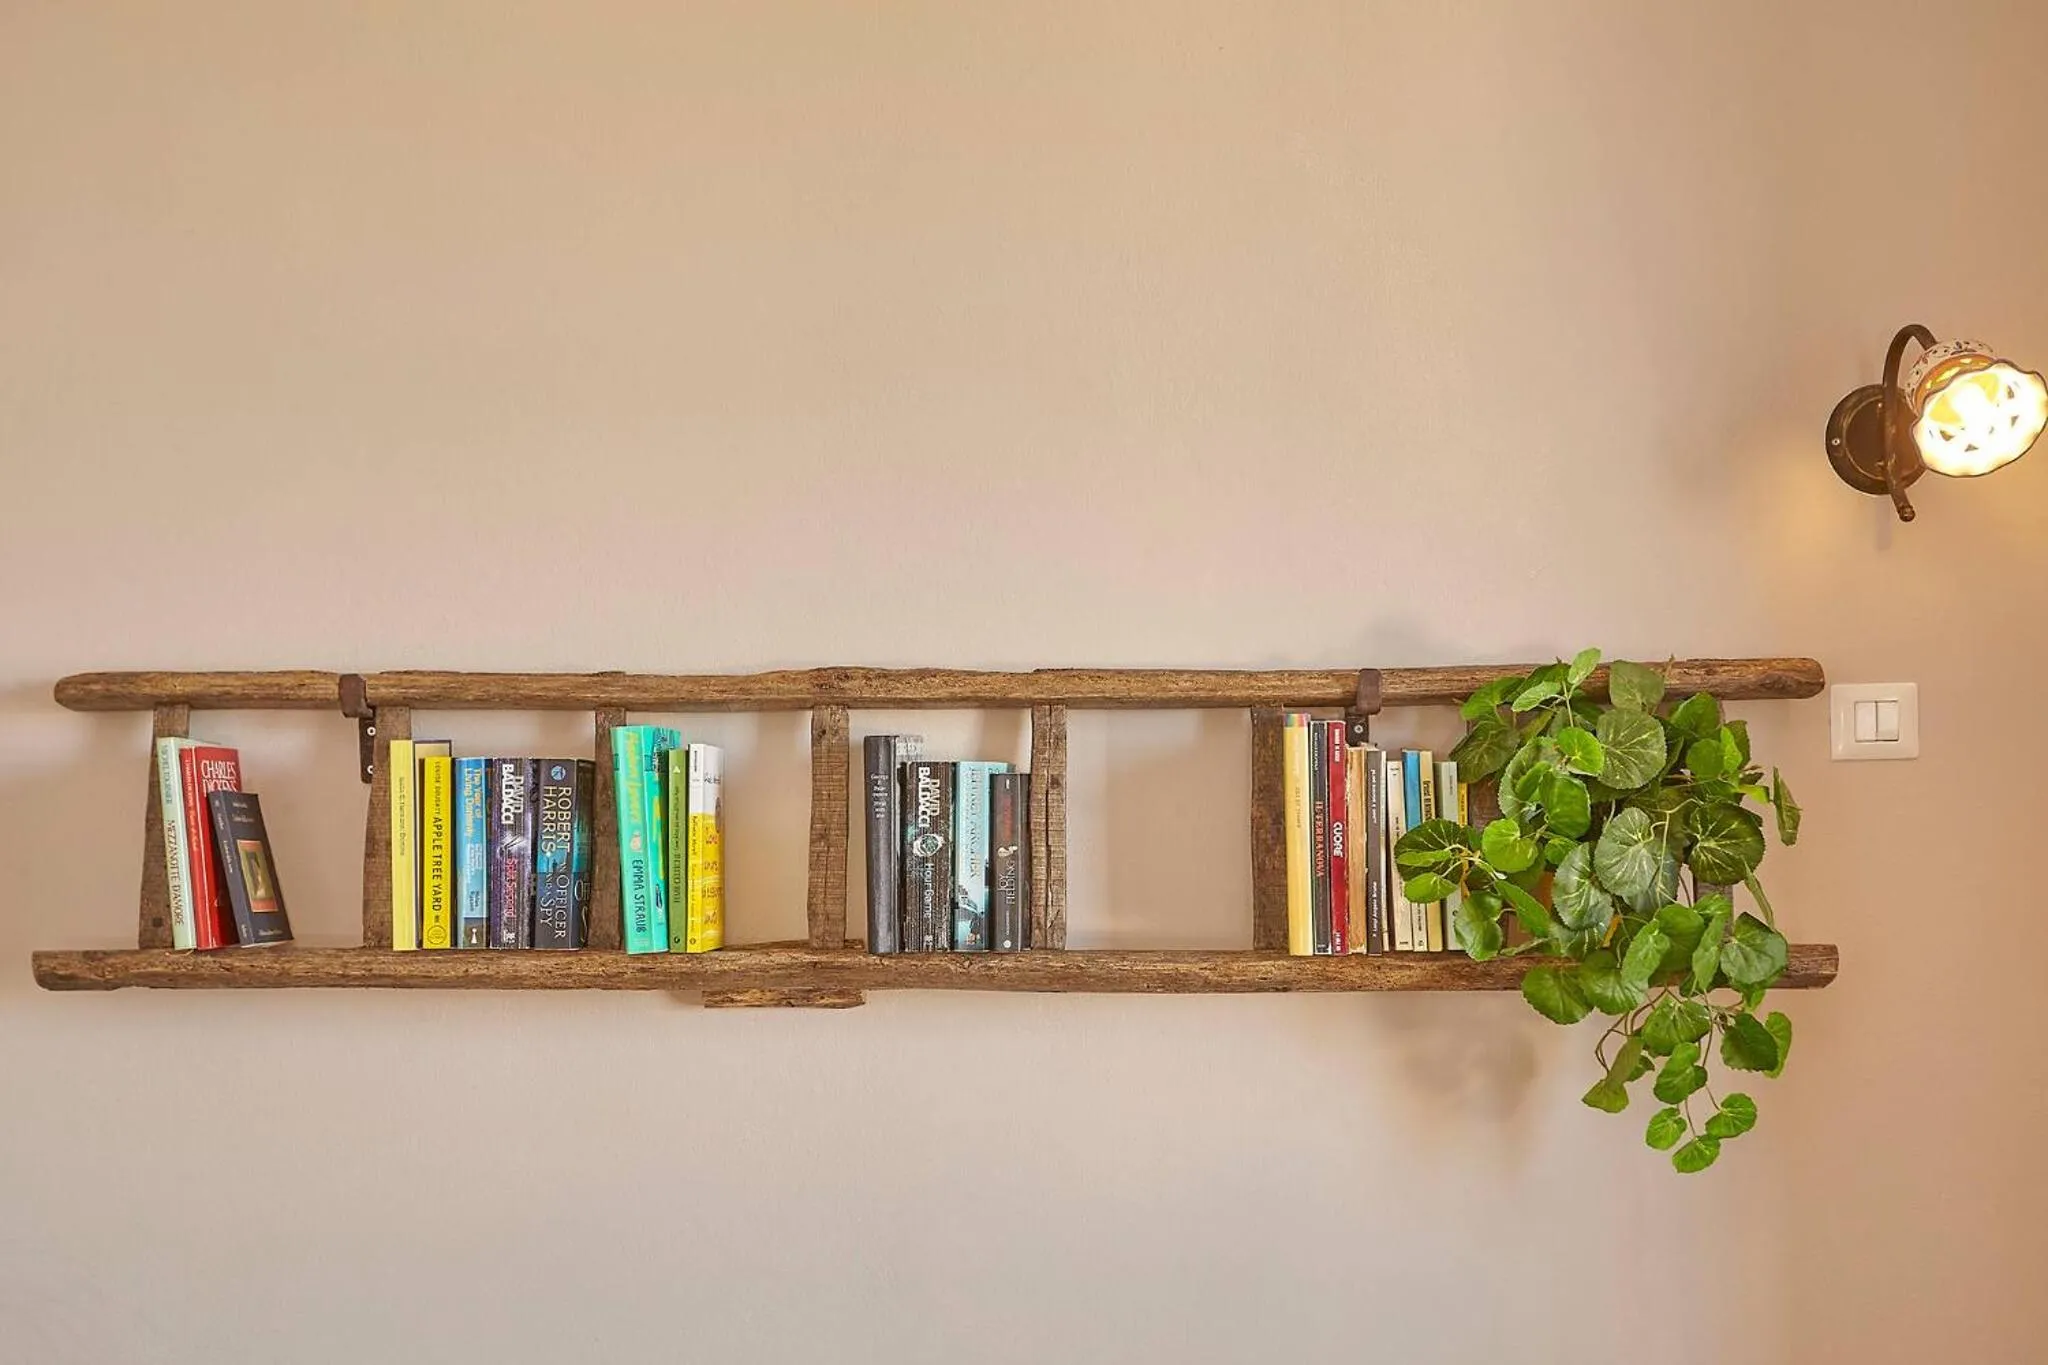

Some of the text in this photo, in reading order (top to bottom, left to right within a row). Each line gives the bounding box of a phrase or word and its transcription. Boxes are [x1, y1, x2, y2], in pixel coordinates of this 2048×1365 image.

[202, 760, 237, 779] CHARLES
[502, 763, 514, 825] BALDACCI
[514, 775, 524, 813] DAVID
[918, 766, 931, 828] BALDACCI
[930, 778, 940, 817] DAVID
[432, 817, 443, 850] APPLE
[541, 785, 557, 853] HARRIS
[556, 786, 572, 852] ROBERT
[1333, 822, 1343, 858] CUORE
[165, 819, 181, 883] MEZZANOTTE
[432, 854, 443, 880] TREE
[432, 886, 443, 911] YARD
[632, 858, 646, 932] EMMA STRAUB
[923, 863, 935, 919] Hour Game
[997, 873, 1009, 892] JOY
[1006, 860, 1016, 905] FIELDING
[171, 884, 185, 926] D'AMORE
[540, 897, 555, 928] SPY
[554, 874, 570, 939] OFFICER
